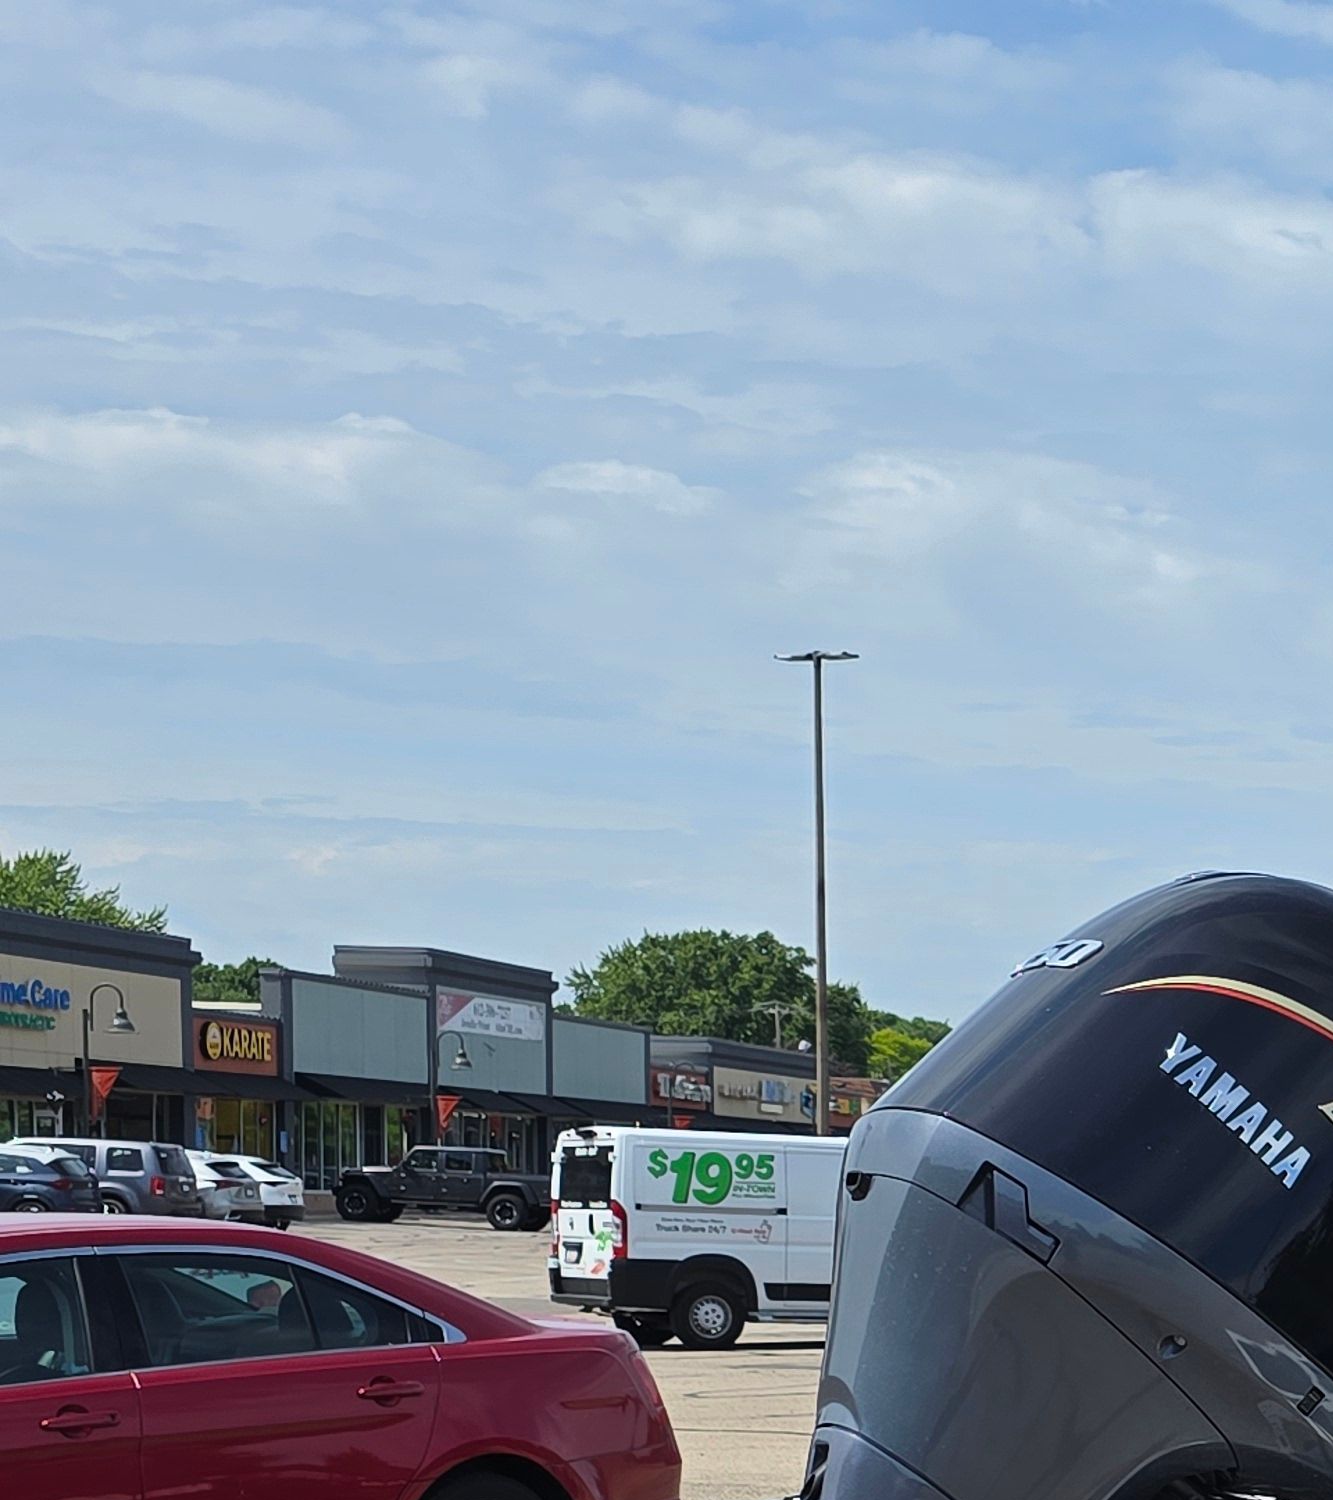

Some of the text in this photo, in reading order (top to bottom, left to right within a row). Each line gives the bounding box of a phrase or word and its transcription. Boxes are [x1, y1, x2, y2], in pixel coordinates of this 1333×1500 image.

[30, 979, 71, 1010] Care
[223, 1027, 272, 1061] KARATE
[1158, 1032, 1311, 1190] YAMAHA
